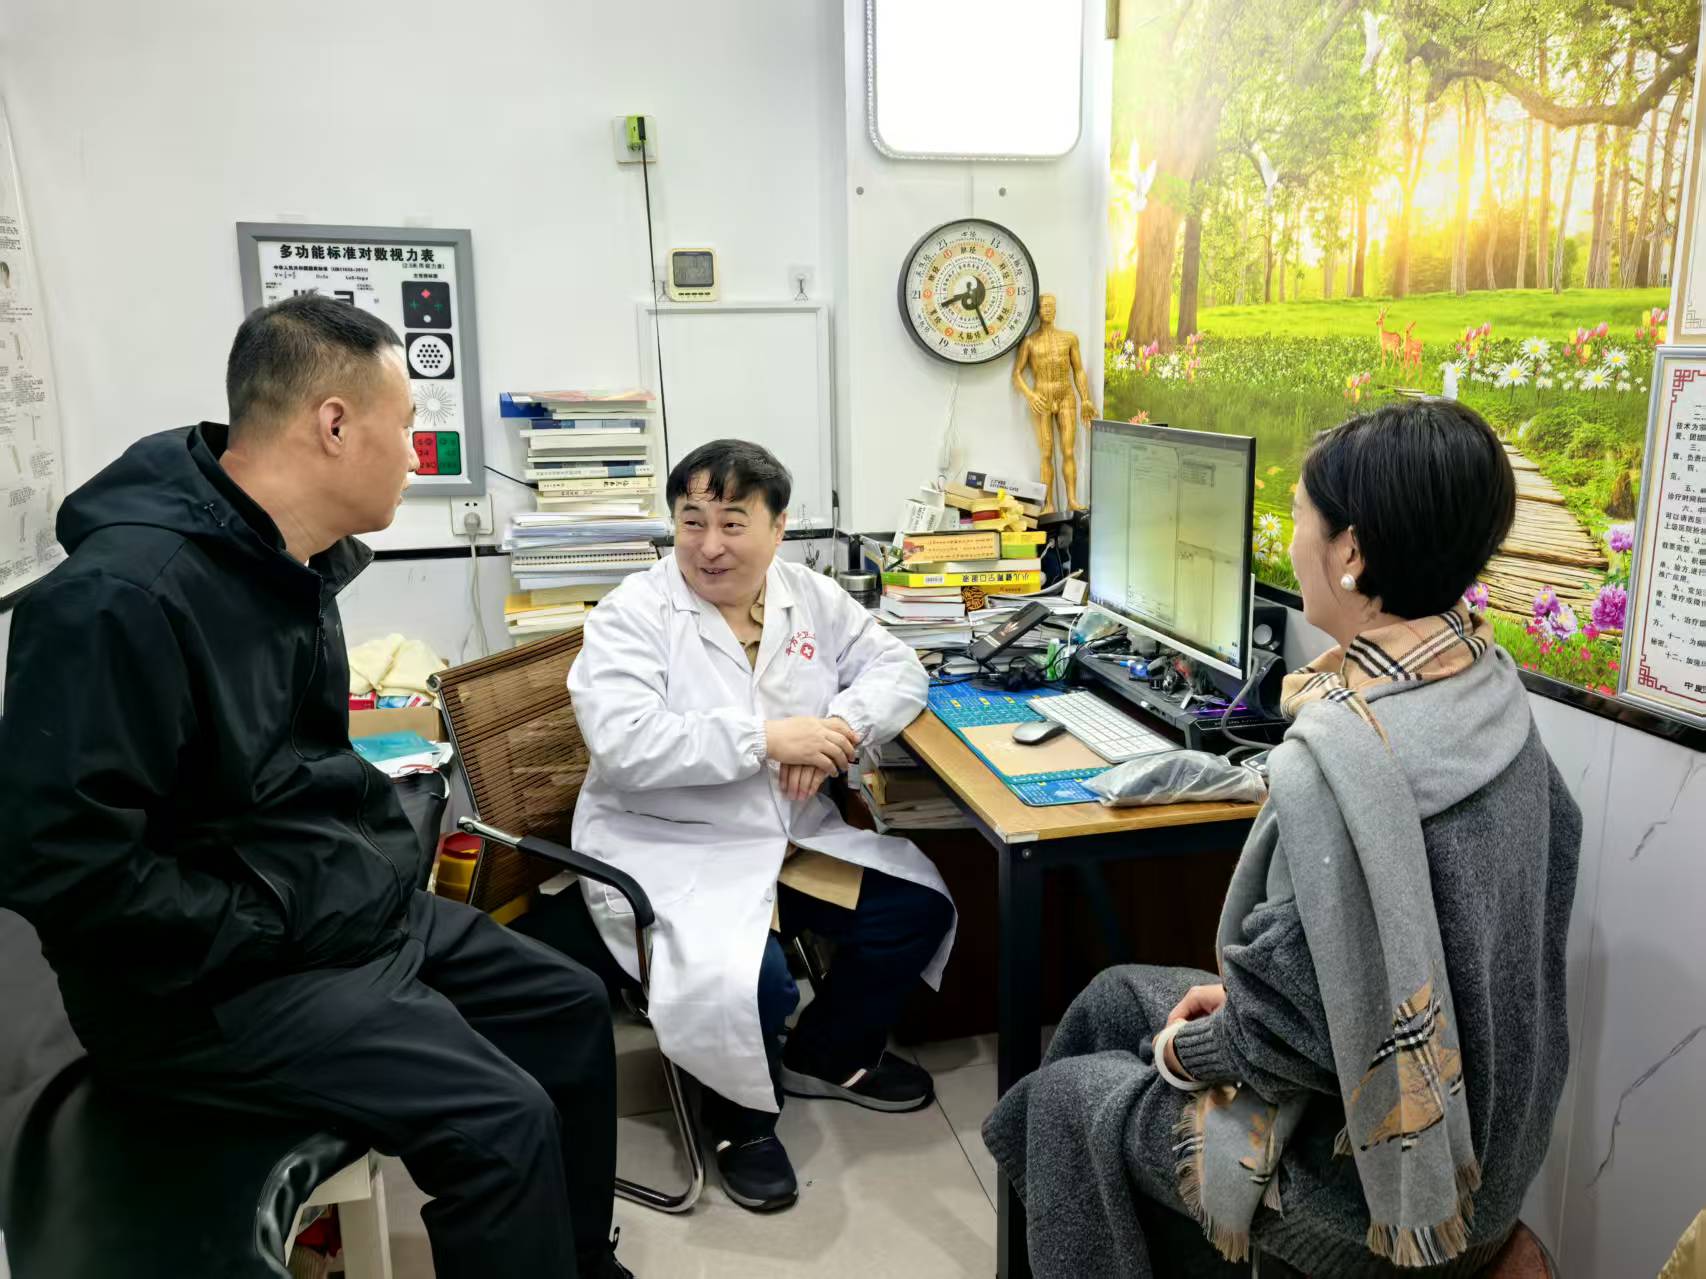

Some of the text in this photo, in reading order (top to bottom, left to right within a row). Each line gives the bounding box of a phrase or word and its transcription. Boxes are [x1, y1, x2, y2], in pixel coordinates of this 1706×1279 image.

[280, 244, 435, 263] 多功能标准对数视力表
